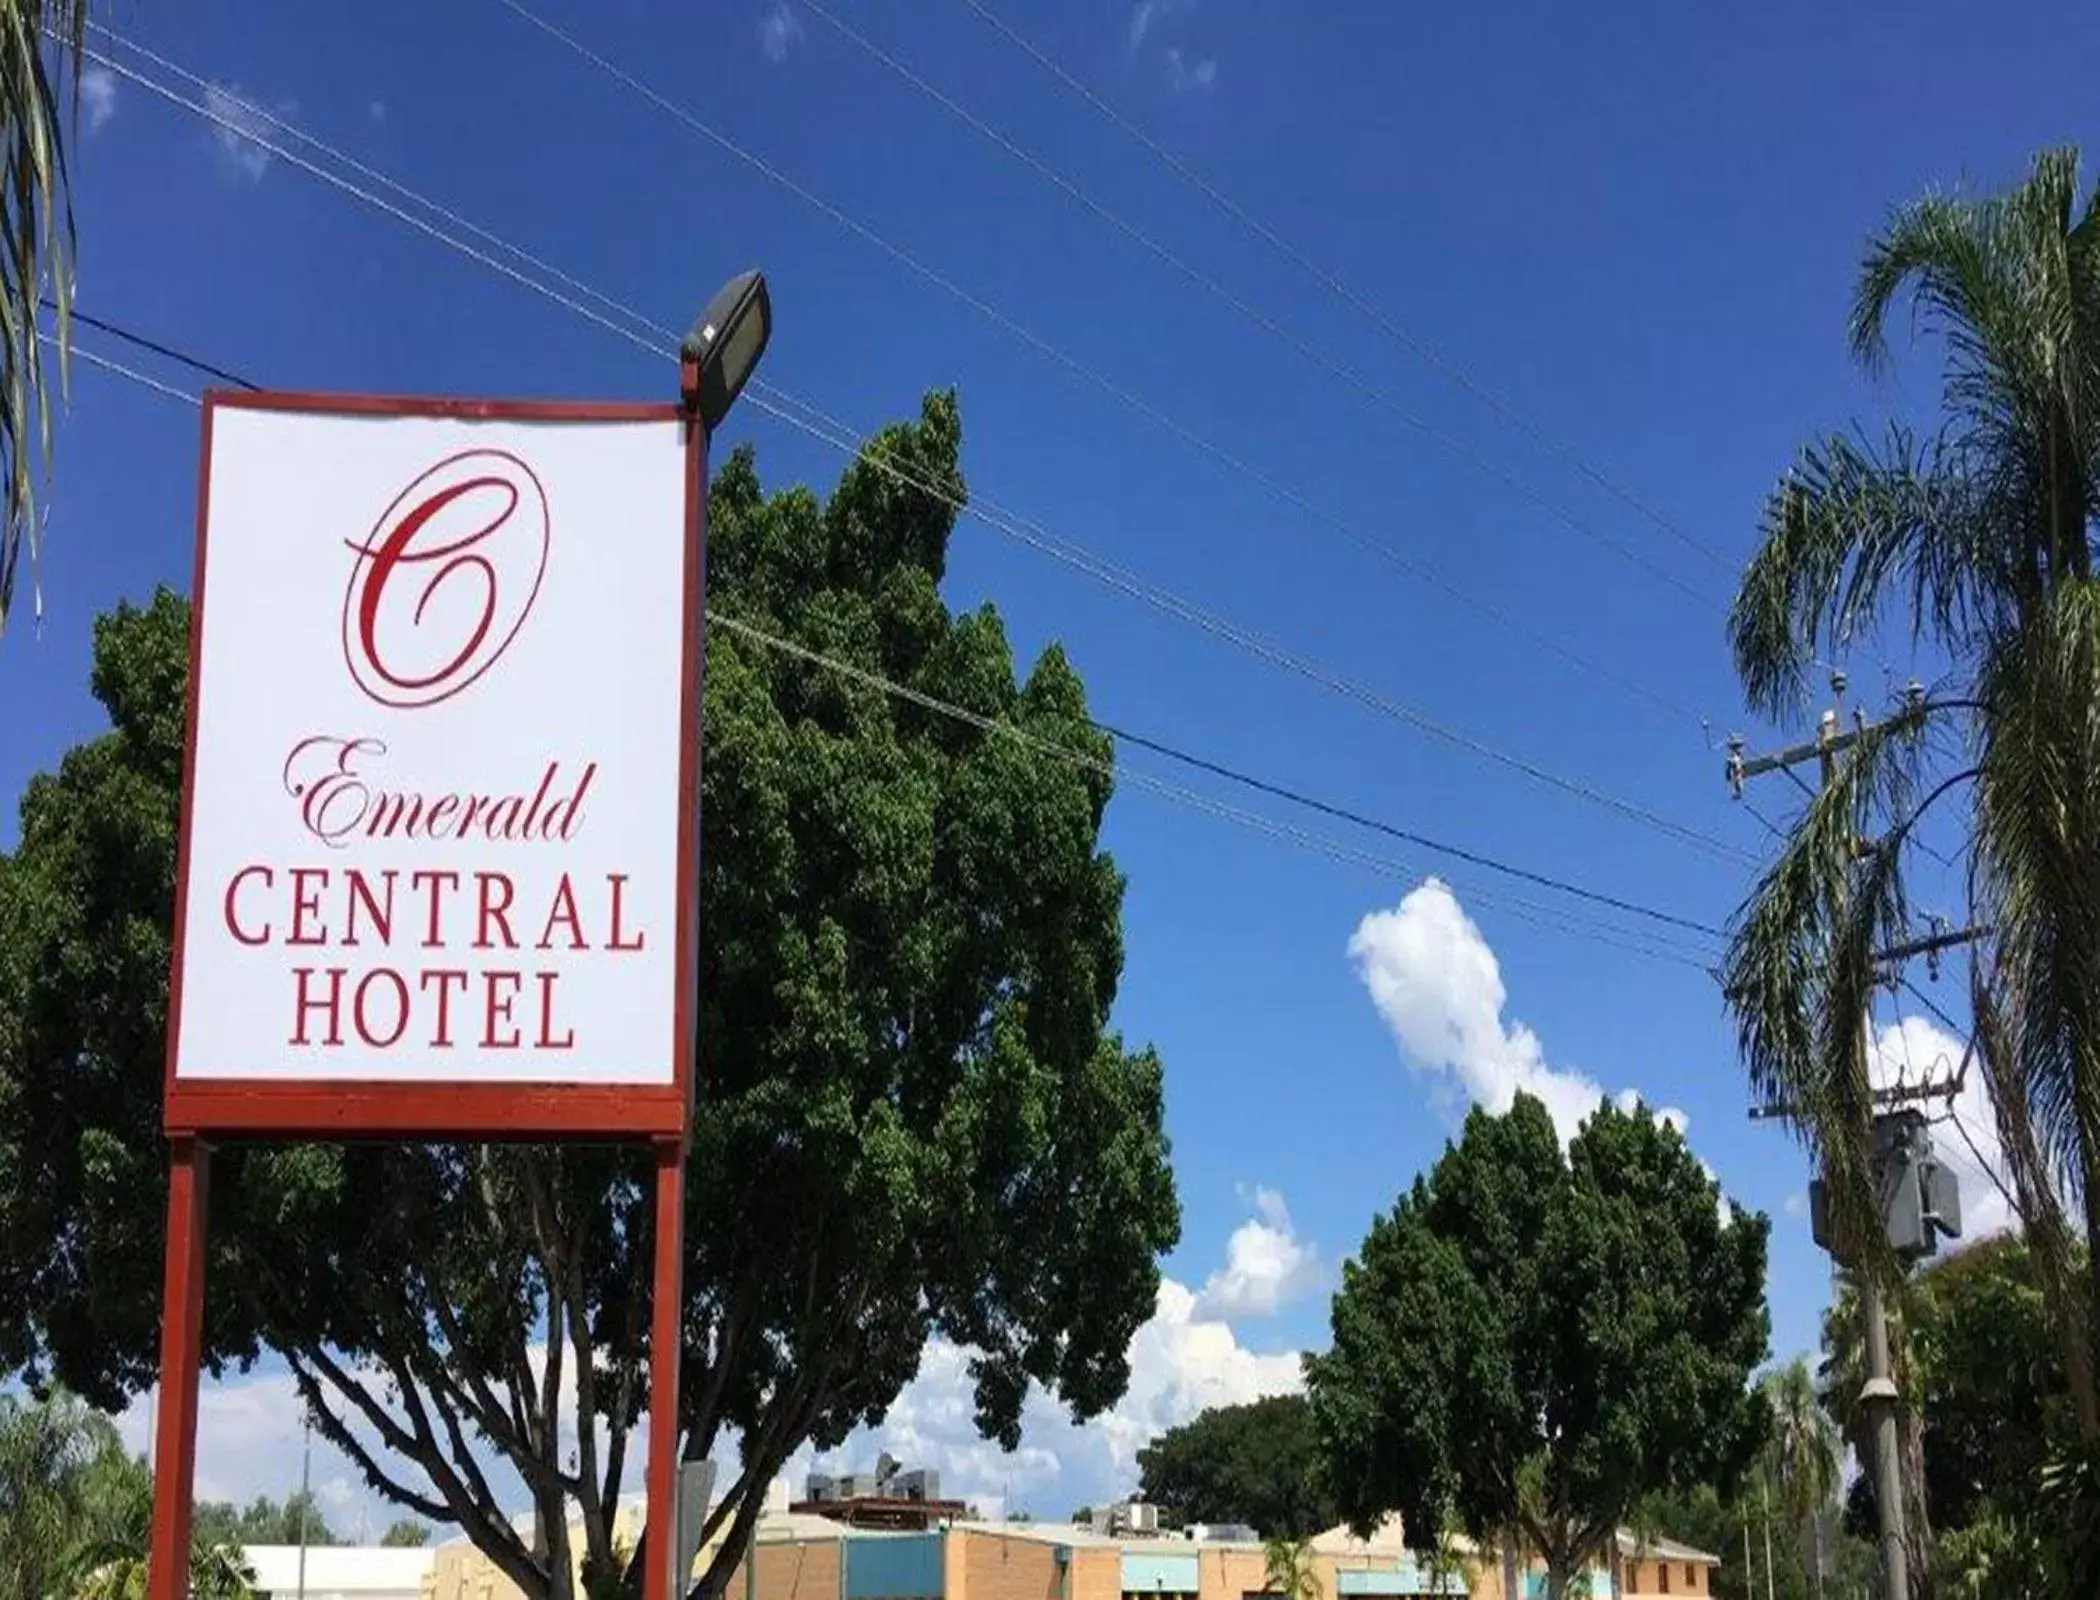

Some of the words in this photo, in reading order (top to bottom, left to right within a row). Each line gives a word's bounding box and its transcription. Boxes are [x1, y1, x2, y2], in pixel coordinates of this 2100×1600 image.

[283, 736, 598, 848] Emerald
[223, 864, 646, 953] CENTRAL
[289, 965, 577, 1051] HOTEL
